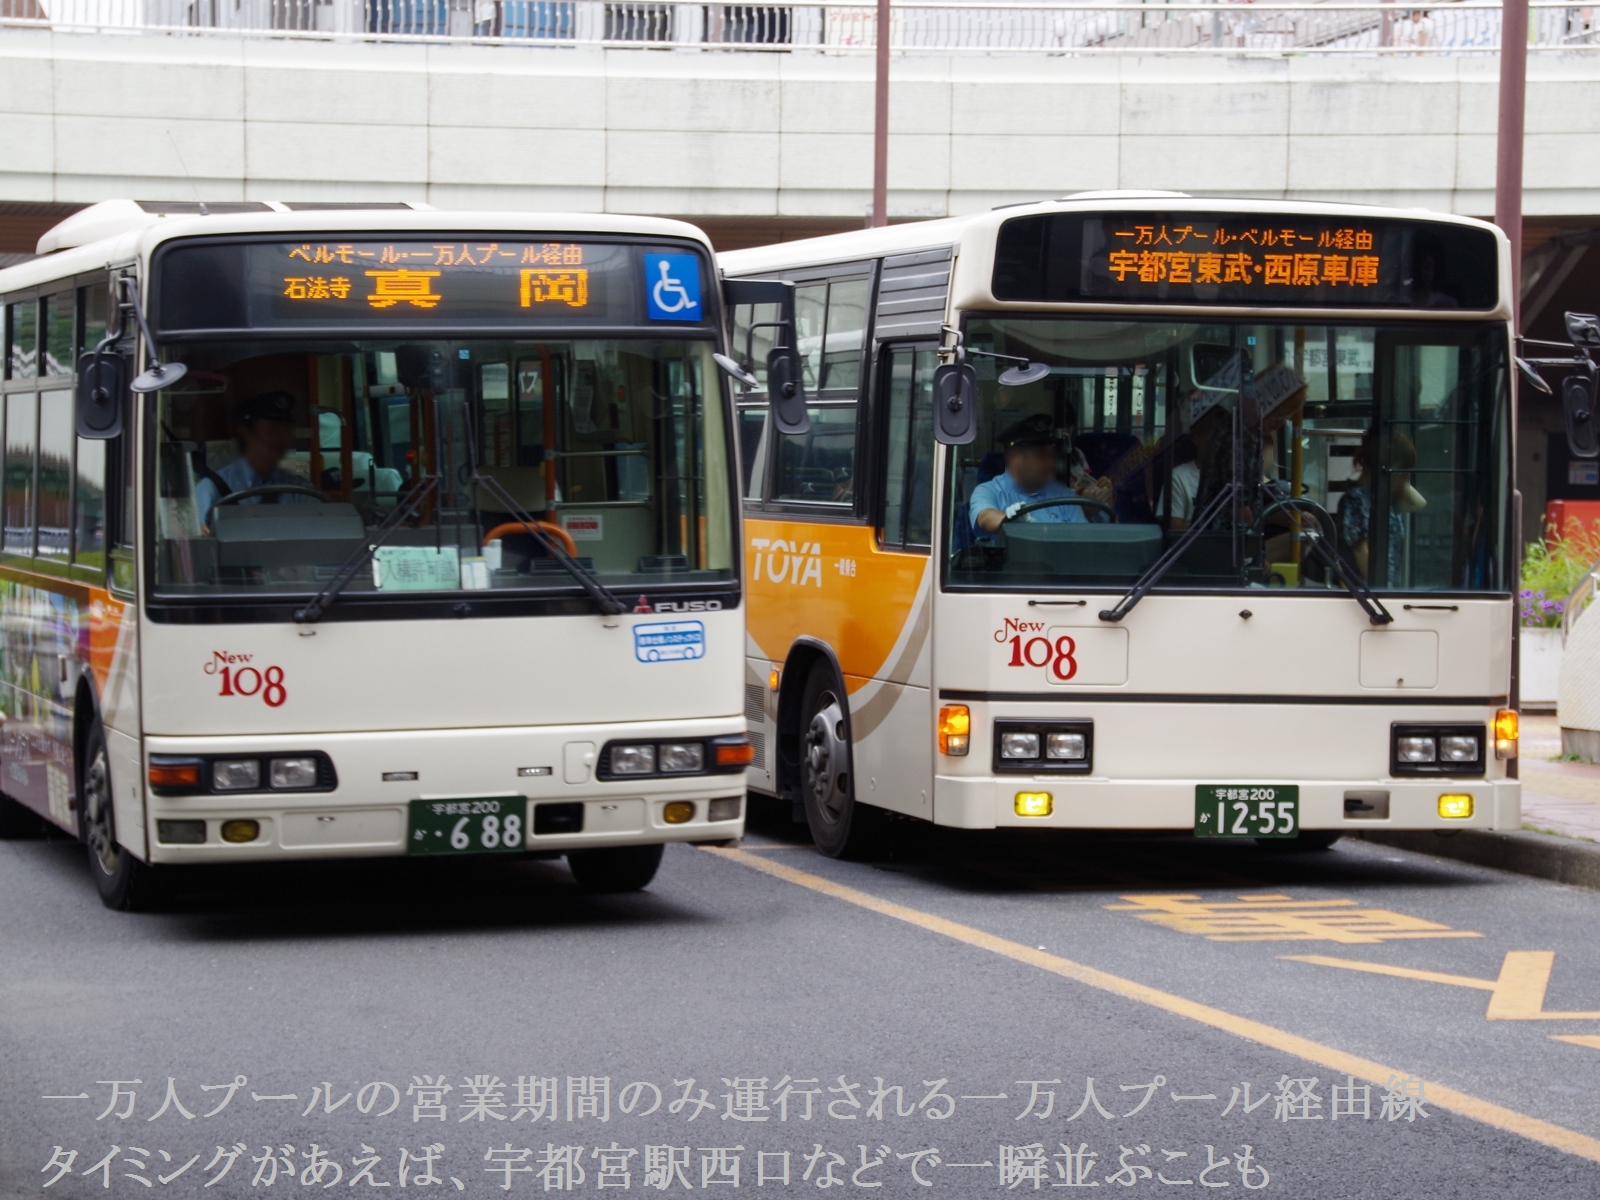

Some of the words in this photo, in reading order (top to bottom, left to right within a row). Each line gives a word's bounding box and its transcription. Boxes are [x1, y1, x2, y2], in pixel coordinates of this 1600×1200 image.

[1108, 250, 1379, 287] 宇都宮東武・西原車庫
[284, 276, 351, 299] 石法寺
[751, 538, 822, 588] TOYA
[654, 600, 722, 613] FUSO
[994, 618, 1045, 643] New
[203, 650, 254, 675] New
[1008, 635, 1077, 681] 108
[218, 665, 287, 708] 108
[1217, 802, 1295, 834] 12-55
